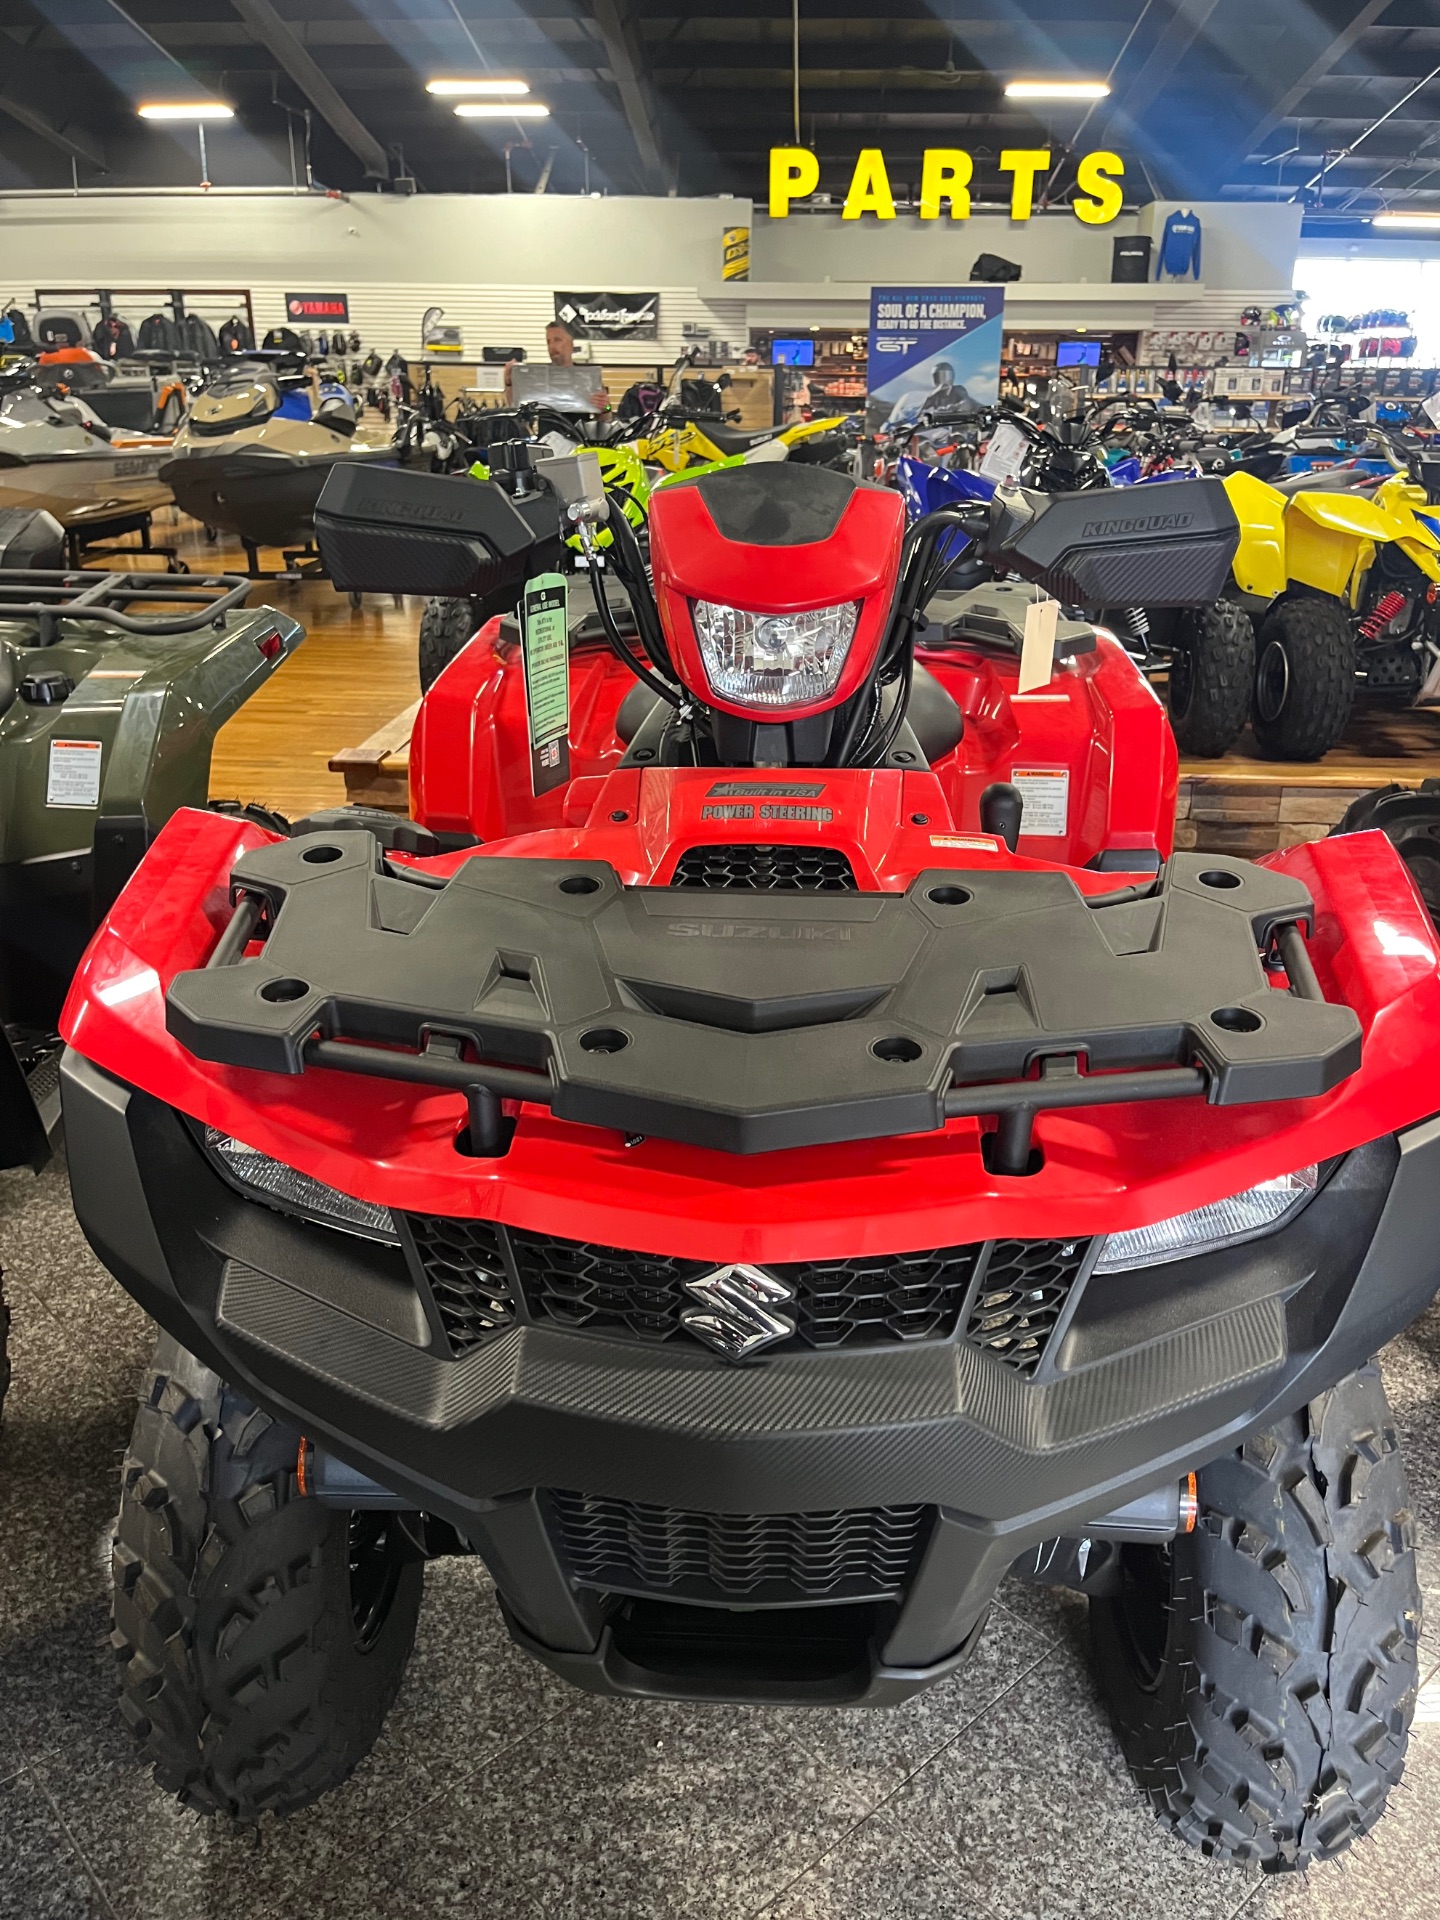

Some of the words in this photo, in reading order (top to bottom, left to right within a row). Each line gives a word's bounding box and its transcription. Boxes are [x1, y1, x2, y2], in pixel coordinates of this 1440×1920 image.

[769, 146, 1125, 225] PARTS
[877, 303, 904, 319] SOUL
[905, 303, 920, 319] OF
[920, 303, 928, 318] A
[928, 303, 987, 320] CHAMPION,
[1081, 512, 1195, 538] KINGQUAD
[734, 788, 768, 796] Built
[769, 788, 783, 796] in
[785, 789, 816, 797] USA
[701, 804, 754, 820] POWER
[759, 804, 834, 822] STEERING
[667, 923, 851, 941] SUZUKI
